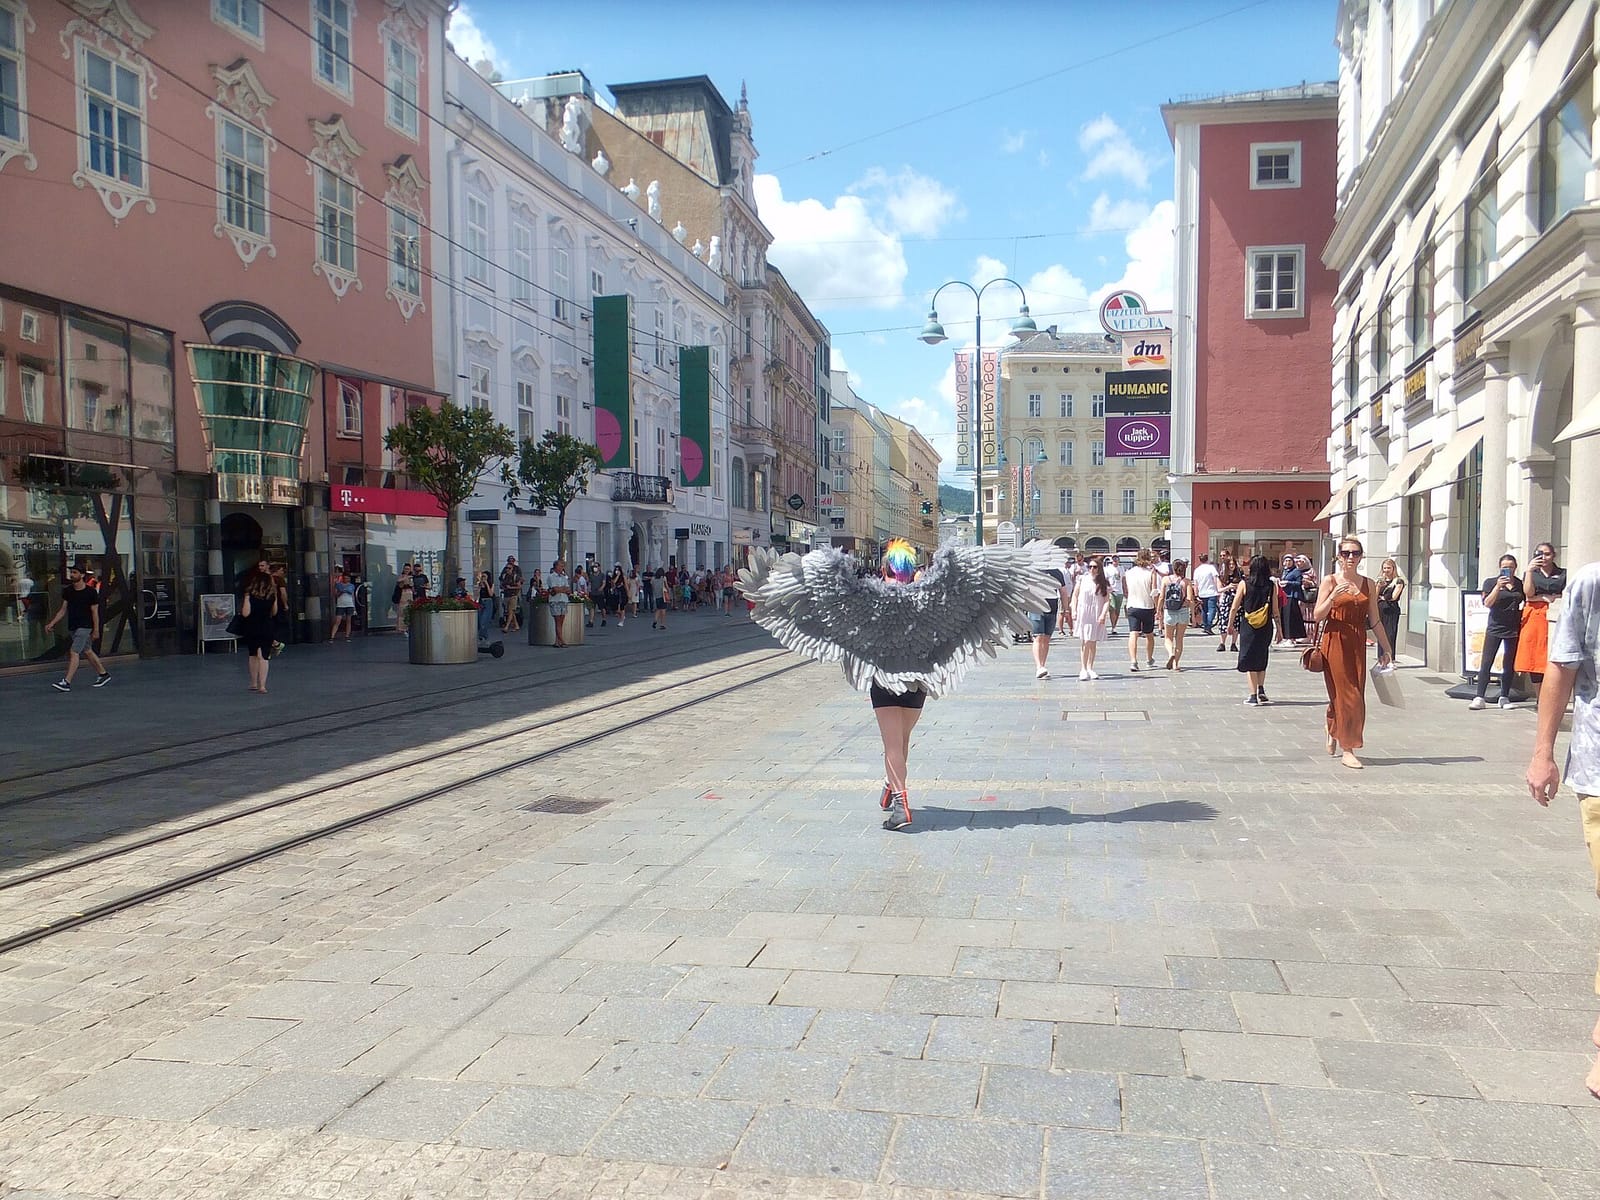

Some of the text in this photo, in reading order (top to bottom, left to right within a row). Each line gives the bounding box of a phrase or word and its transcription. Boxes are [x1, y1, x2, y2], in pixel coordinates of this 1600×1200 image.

[1106, 309, 1142, 317] PIZZERIA
[1113, 317, 1164, 330] VERONA
[1133, 339, 1162, 356] dm
[1109, 382, 1169, 396] HUMANIC
[1131, 426, 1149, 436] Jack
[1124, 433, 1154, 443] Ripperl
[72, 542, 93, 550] Kunst
